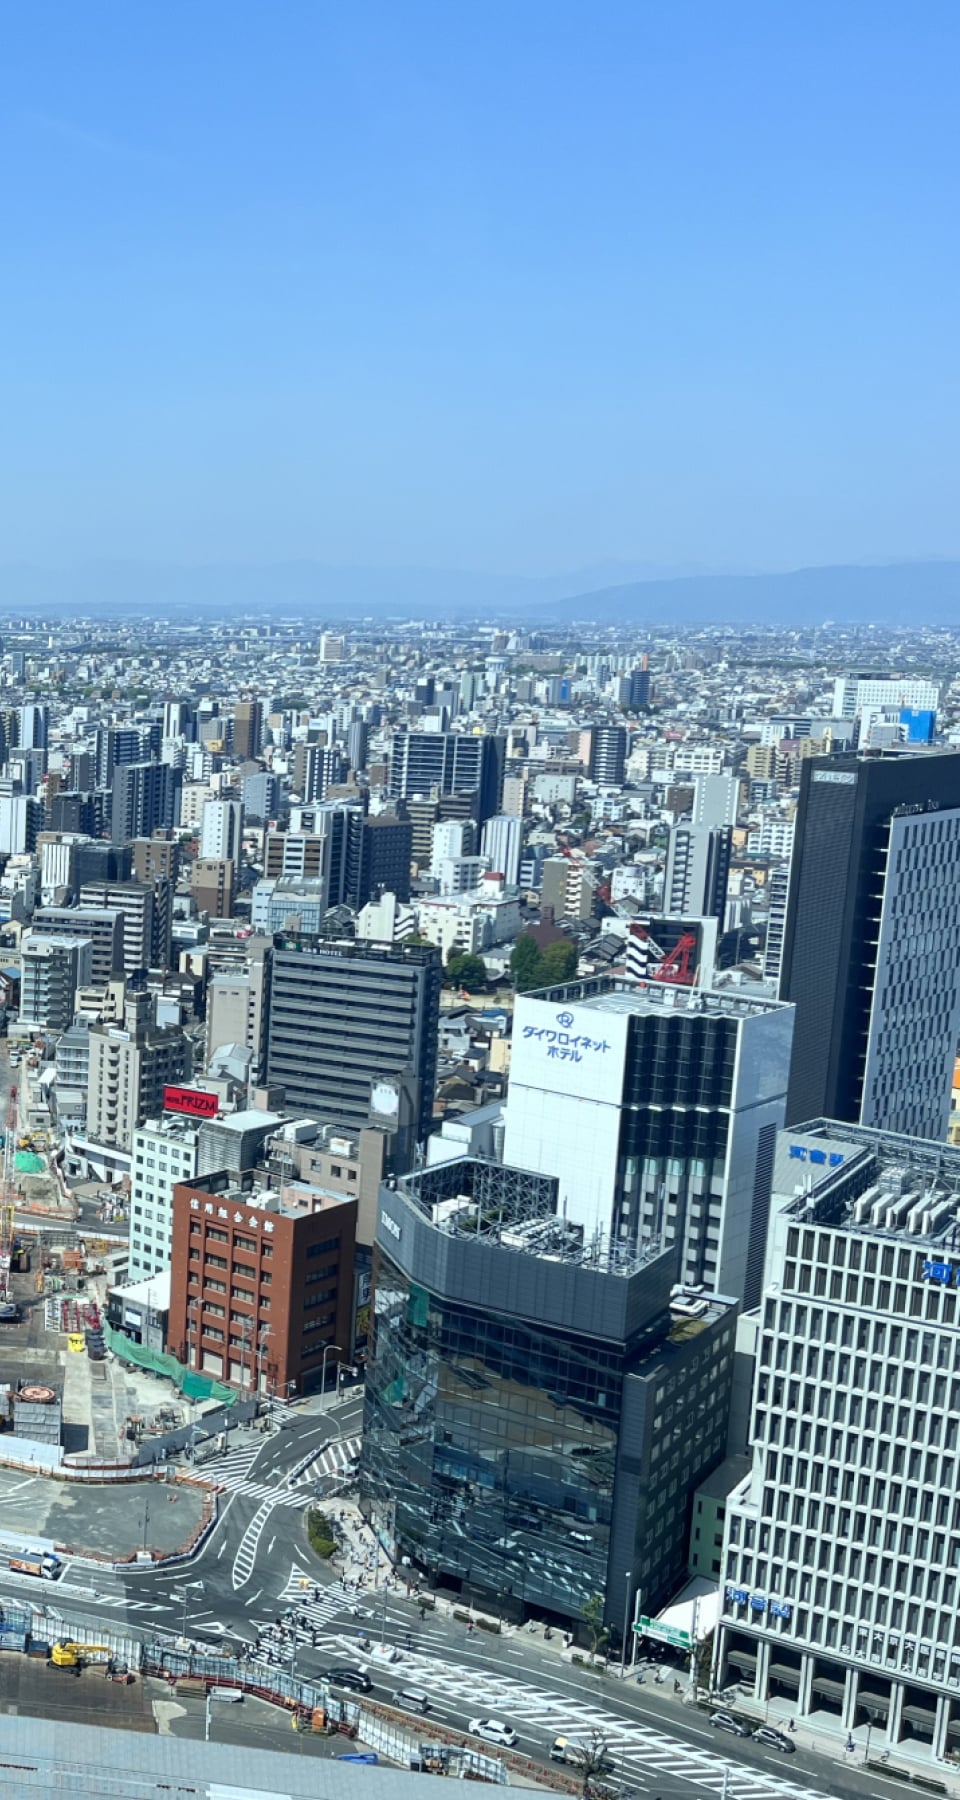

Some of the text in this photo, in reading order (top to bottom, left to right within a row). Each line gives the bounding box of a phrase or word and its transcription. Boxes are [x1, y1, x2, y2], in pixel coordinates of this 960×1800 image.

[522, 1025, 611, 1053] ダイワロイネット
[547, 1045, 583, 1062] ホテル
[921, 1260, 960, 1286] 河
